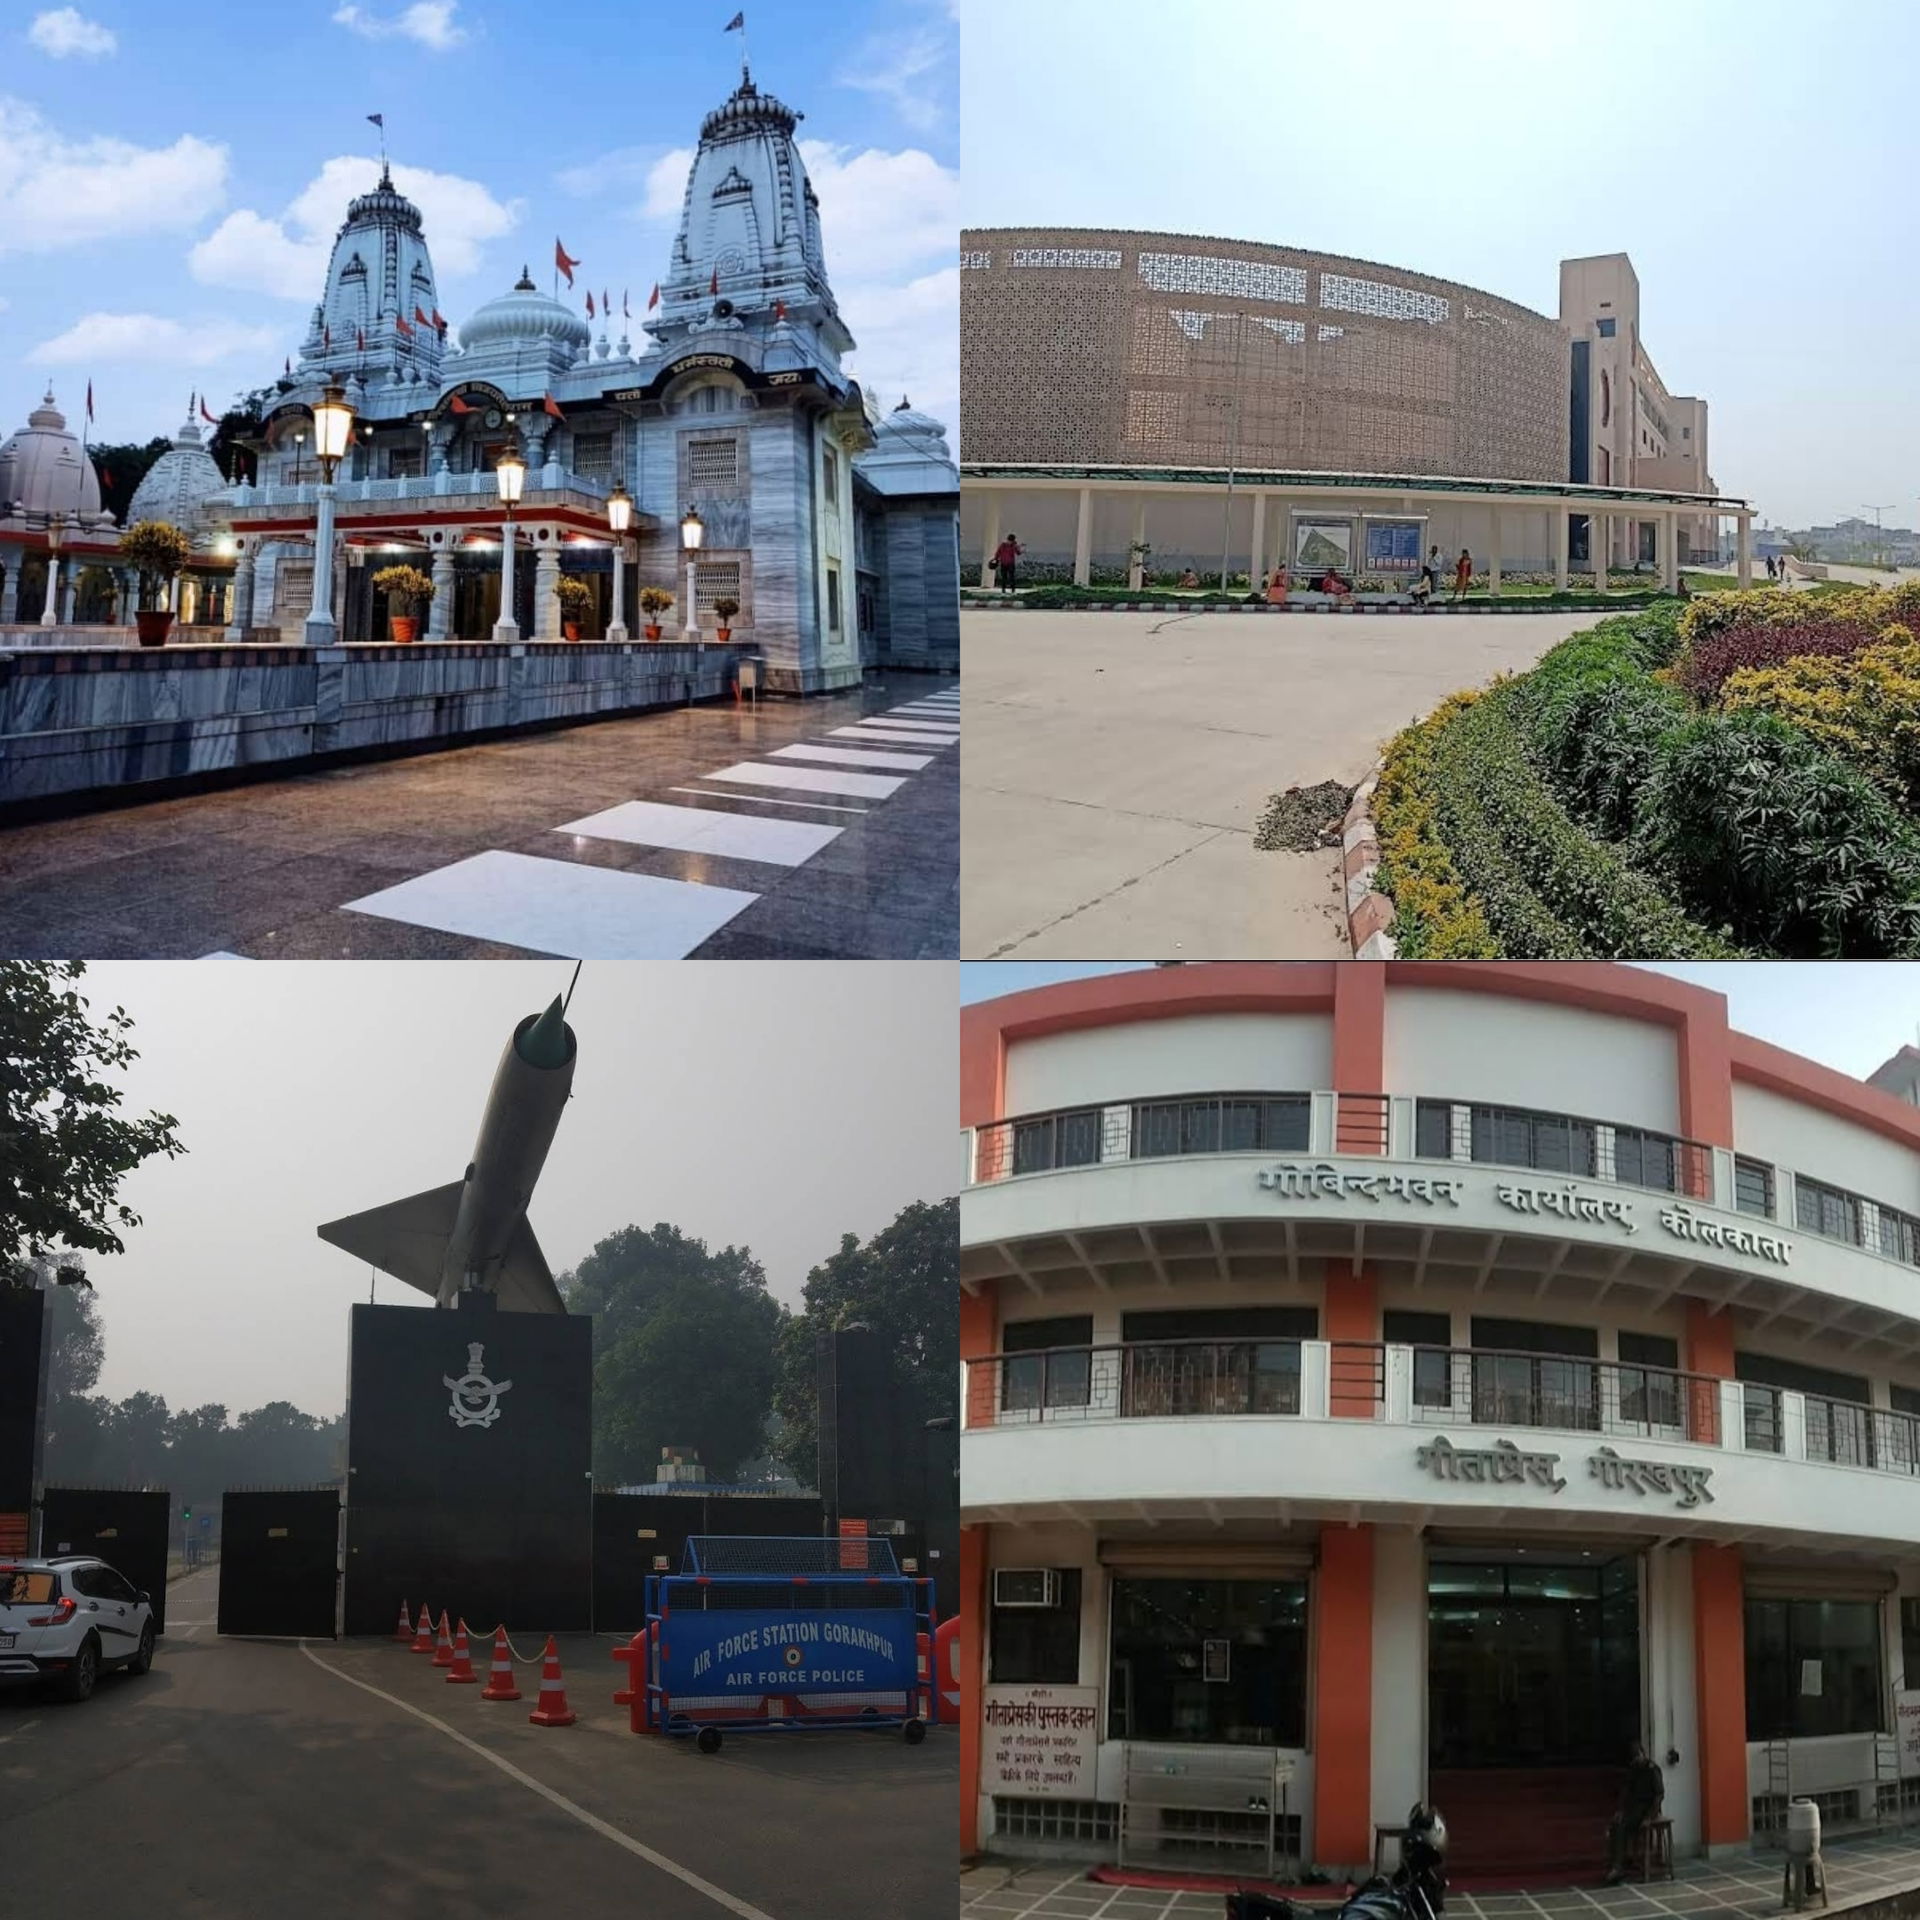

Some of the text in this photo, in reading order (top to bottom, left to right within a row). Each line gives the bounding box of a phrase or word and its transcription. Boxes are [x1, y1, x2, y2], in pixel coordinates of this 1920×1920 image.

[1660, 1203, 1793, 1266] कोलकाता
[1417, 1435, 1715, 1508] गीताप्रेस, गोरखपुर
[693, 1622, 894, 1678] AIR FORCE STATION GORAKHPUR
[726, 1670, 865, 1686] AIR FORCE POLICE
[985, 1700, 1037, 1727] गीताप्रेसकी
